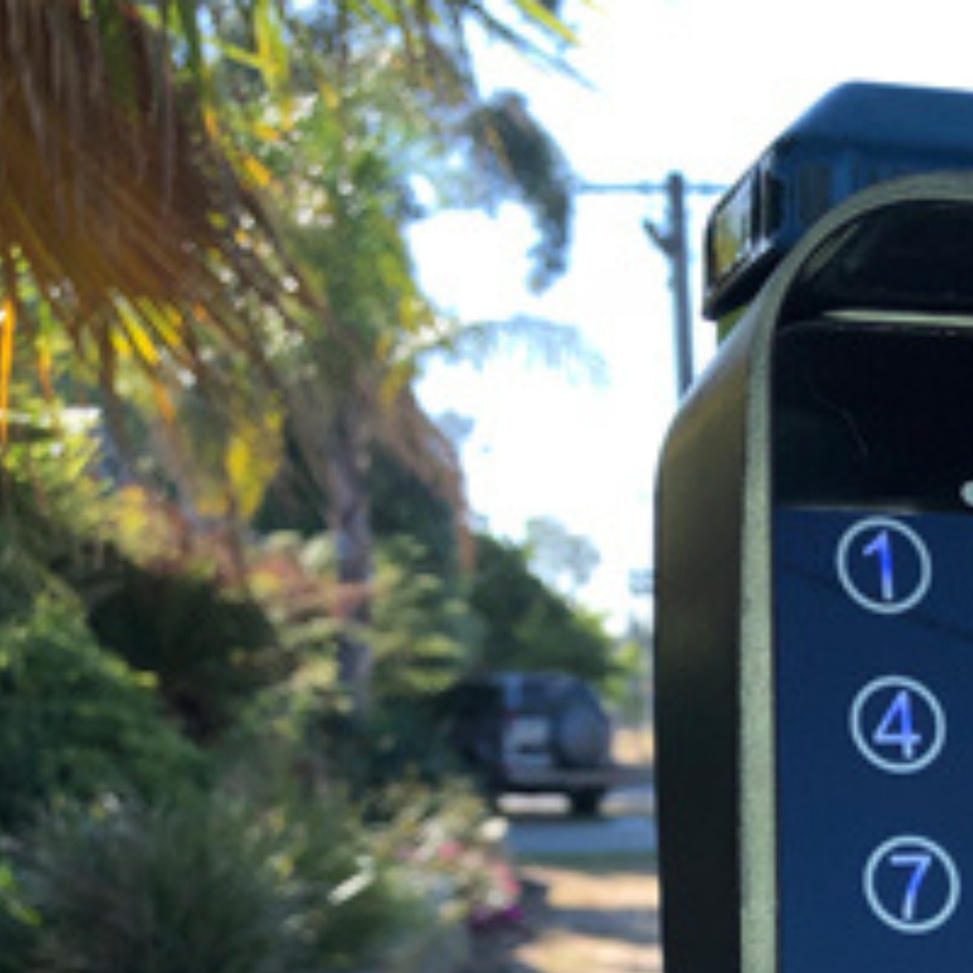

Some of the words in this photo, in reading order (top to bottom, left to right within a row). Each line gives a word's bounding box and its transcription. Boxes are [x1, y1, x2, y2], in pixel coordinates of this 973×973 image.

[863, 530, 893, 600] 1
[872, 690, 922, 760] 4
[889, 854, 933, 921] 7
